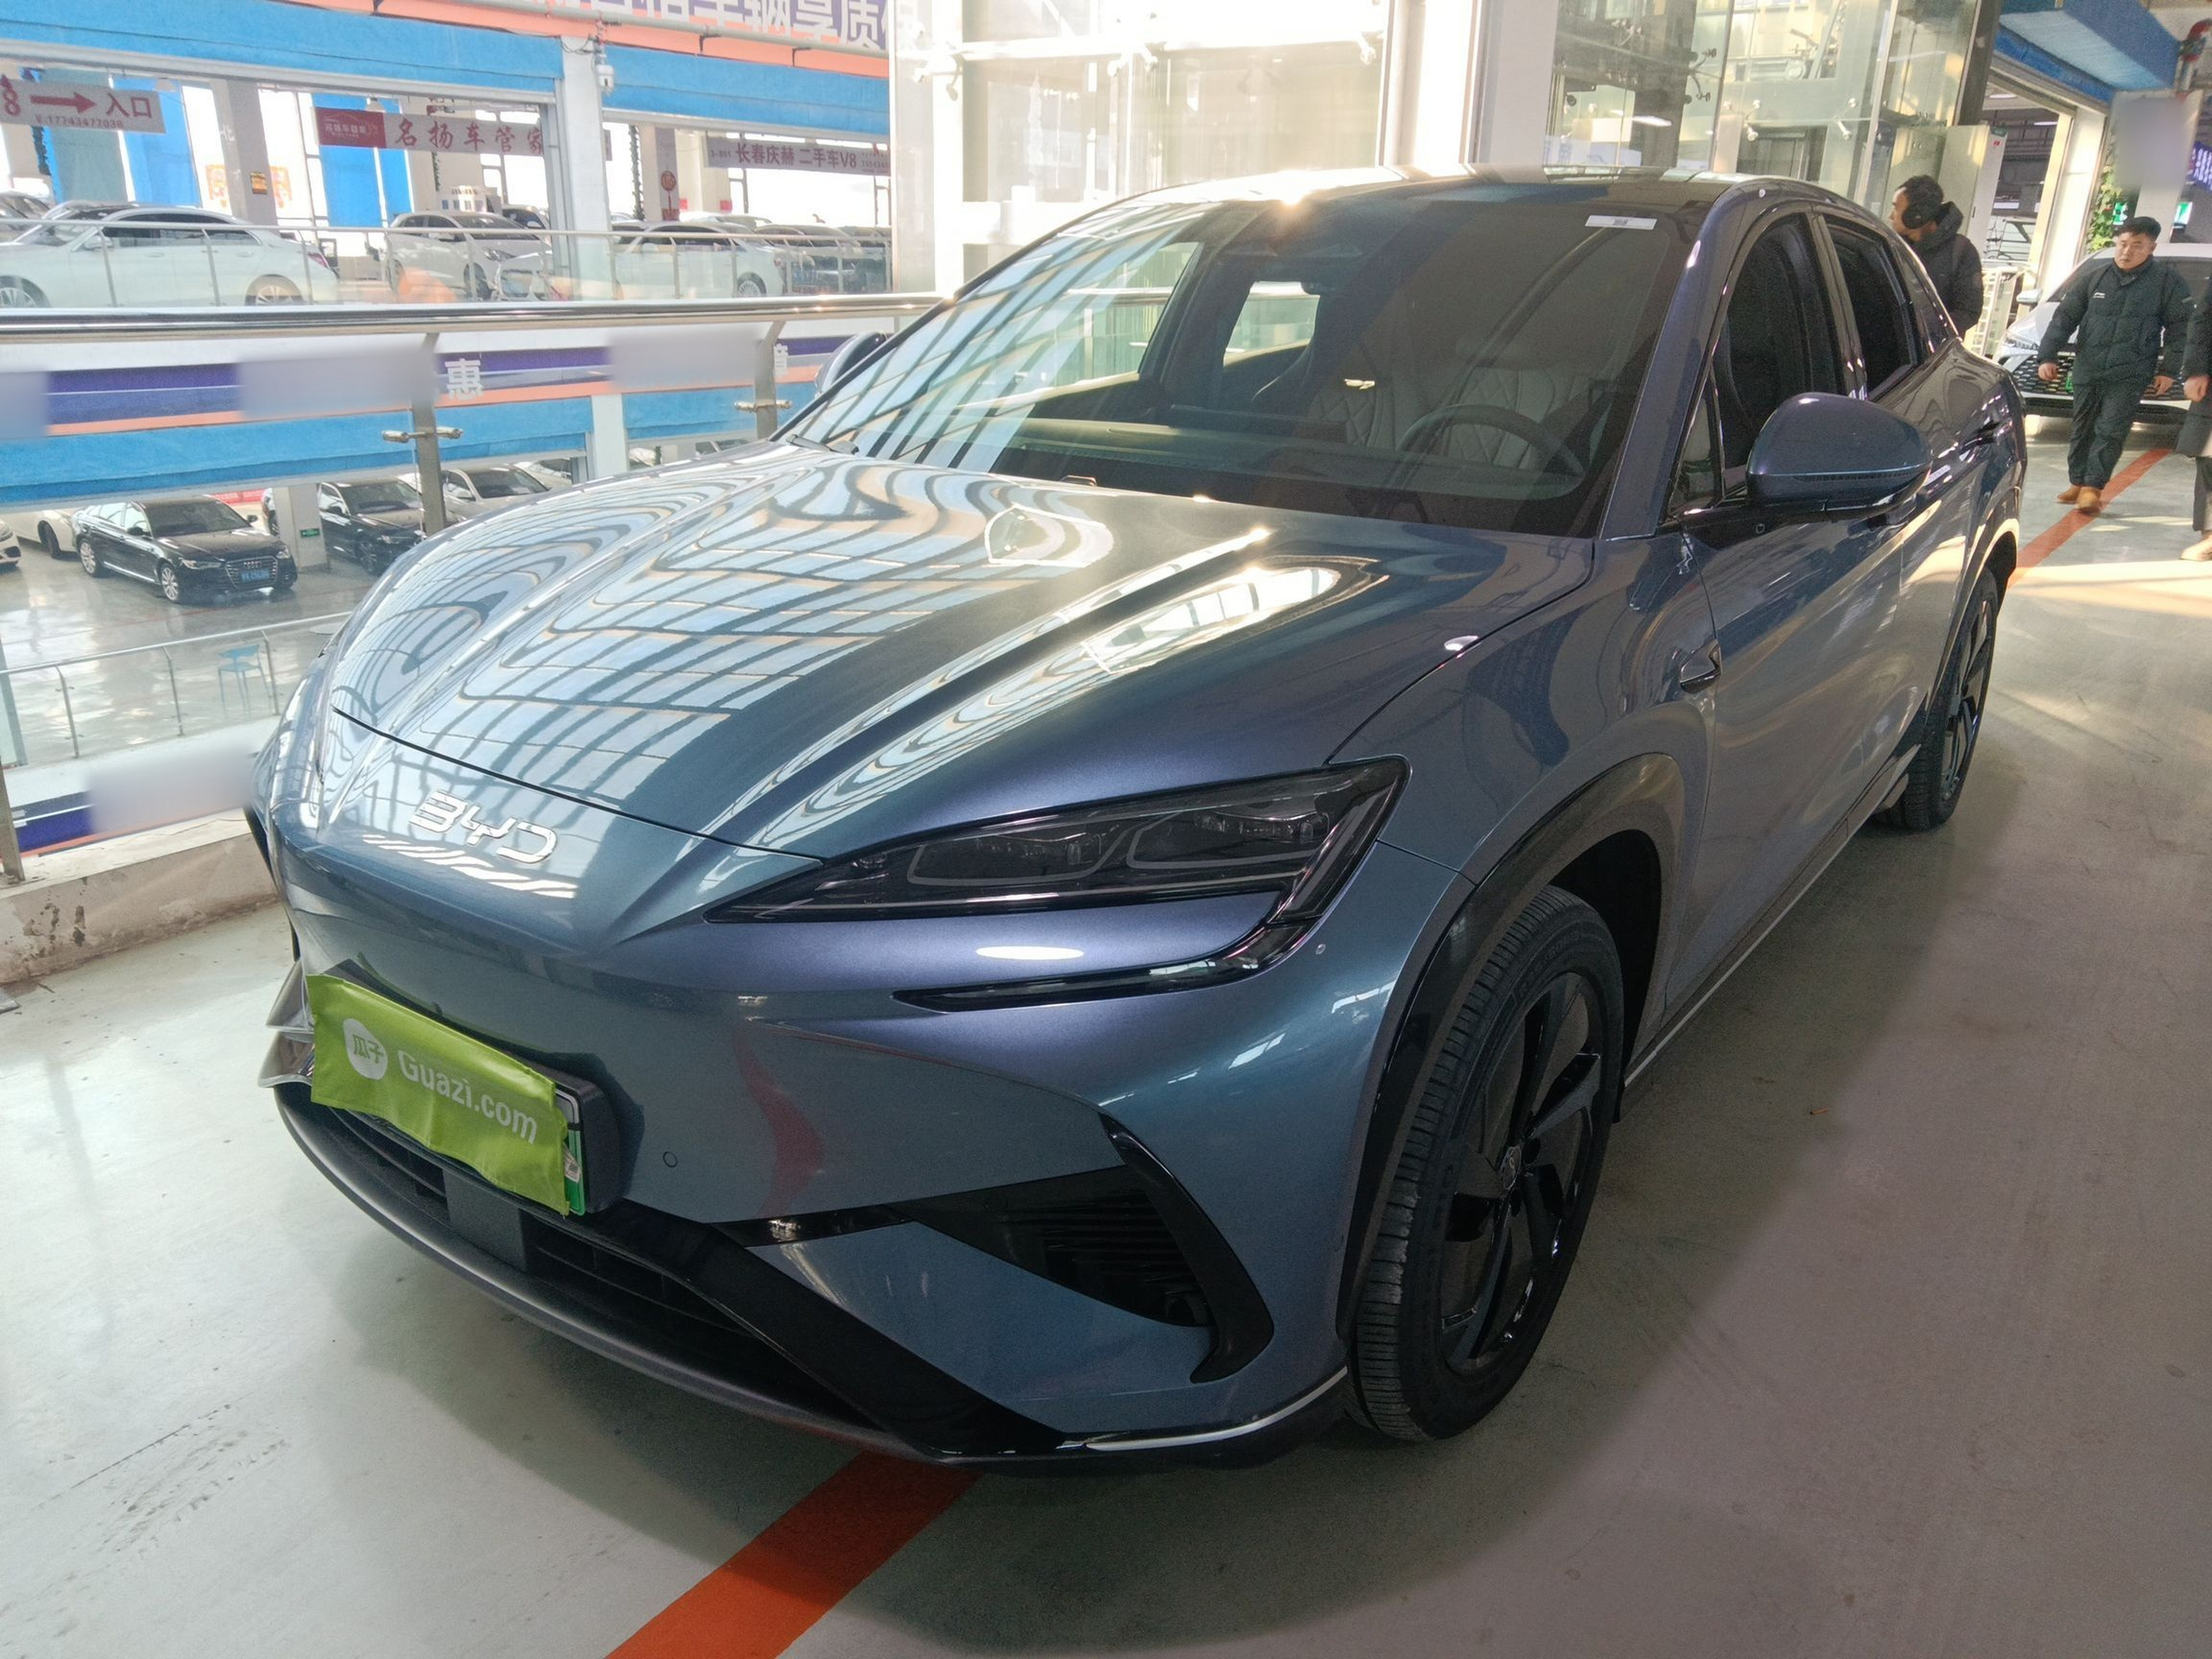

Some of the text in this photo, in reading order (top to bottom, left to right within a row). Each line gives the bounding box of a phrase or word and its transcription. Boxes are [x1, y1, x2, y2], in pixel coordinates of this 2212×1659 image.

[105, 92, 152, 118] 入口
[444, 358, 483, 400] 惠
[408, 790, 558, 863] BYD
[352, 1034, 538, 1145] 瓜子 Guazi.com
